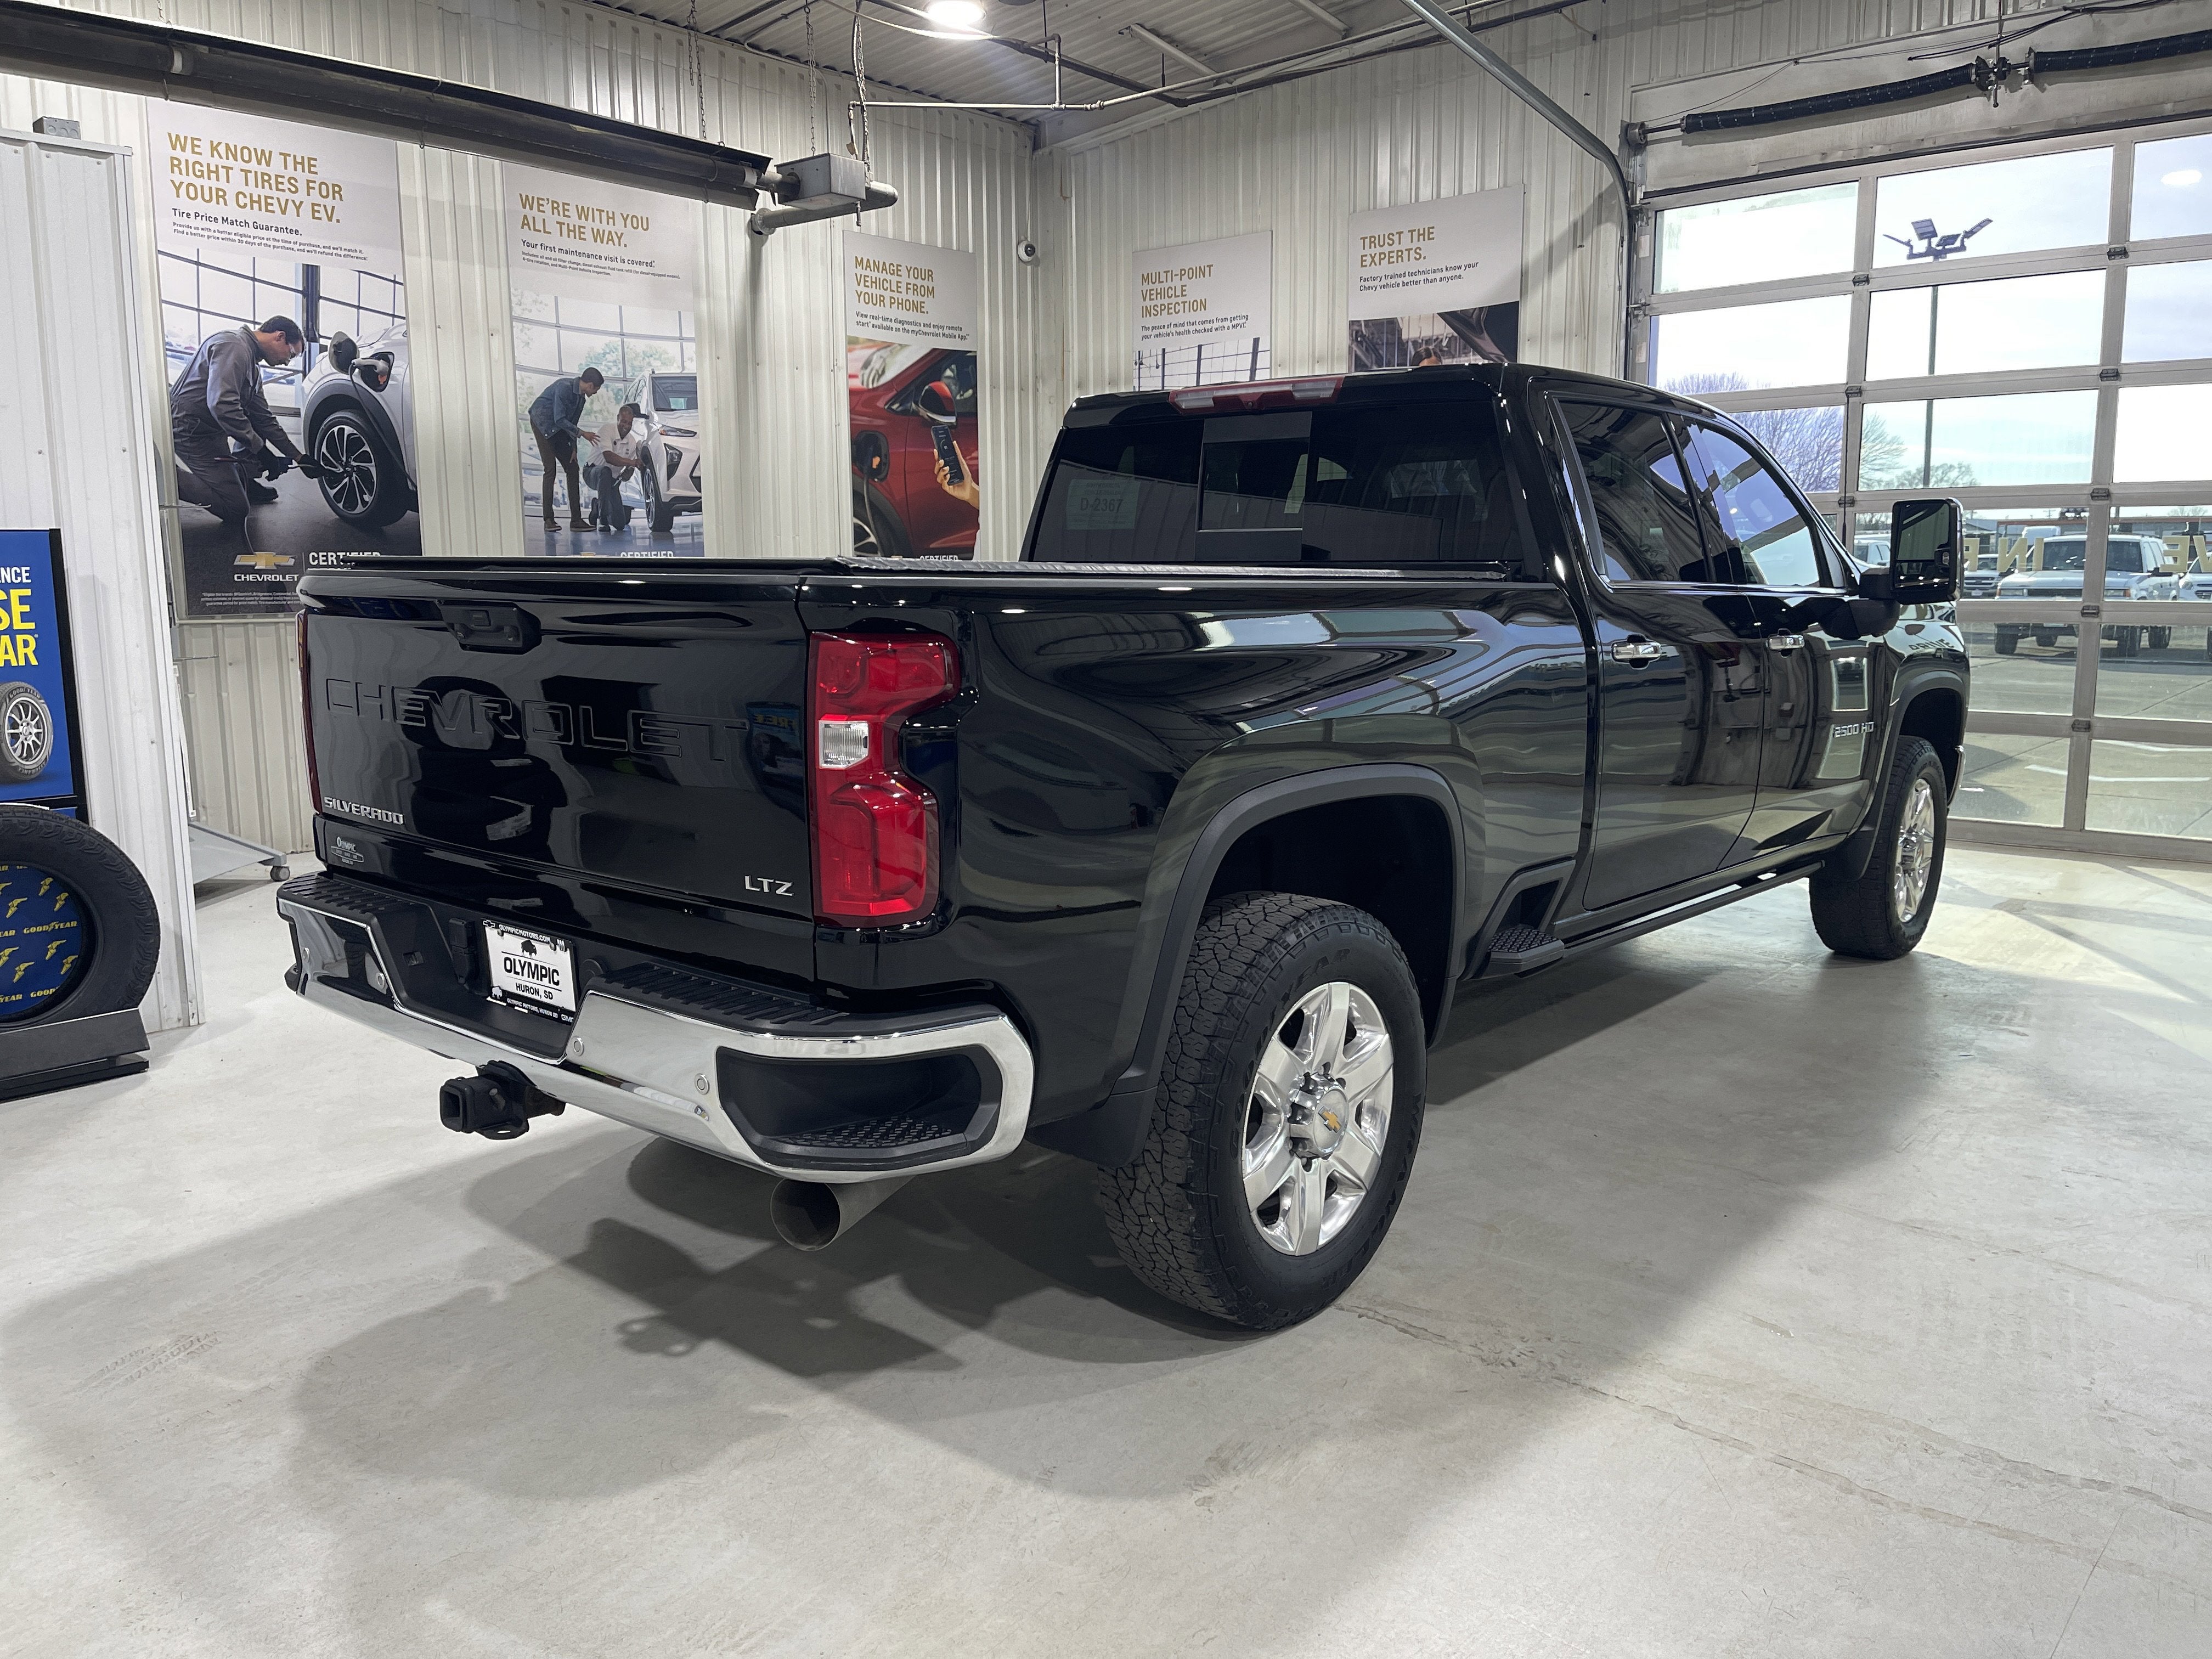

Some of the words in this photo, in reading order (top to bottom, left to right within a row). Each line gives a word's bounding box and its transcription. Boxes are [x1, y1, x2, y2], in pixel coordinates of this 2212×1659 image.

[167, 132, 202, 156] WE
[210, 140, 273, 167] KNOW
[279, 152, 318, 175] THE
[170, 156, 233, 184] RIGHT
[240, 168, 299, 194] TIRES
[306, 179, 344, 201] FOR
[170, 179, 228, 207] YOUR
[235, 191, 304, 217] CHEVY
[311, 202, 340, 223] EV.
[172, 208, 191, 219] Tire
[194, 213, 218, 223] Price
[222, 217, 250, 228] Match
[252, 222, 302, 235] Guarantee.
[519, 193, 571, 218] WE'RE
[575, 205, 616, 227] WITH
[620, 212, 649, 232] YOU
[521, 214, 552, 235] ALL
[556, 221, 586, 241] THE
[591, 227, 627, 247] WAY.
[1360, 230, 1404, 251] TRUST
[1408, 225, 1435, 244] THE
[273, 244, 296, 252] purchase,
[521, 239, 539, 249] Your
[540, 242, 556, 253] first
[558, 247, 602, 261] maintenance
[604, 254, 618, 263] visit
[1360, 246, 1426, 268] EXPERTS.
[855, 256, 902, 277] MANAGE
[905, 265, 934, 283] YOUR
[1141, 264, 1214, 286] MULTI-POINT
[1359, 275, 1383, 283] Factory
[1384, 271, 1406, 280] trained
[1408, 267, 1443, 278] technicians
[1445, 263, 1463, 272] know
[1464, 262, 1479, 271] your
[855, 273, 902, 294] VEHICLE
[905, 282, 935, 299] FROM
[1141, 284, 1187, 302] VEHICLE
[1359, 283, 1378, 292] Chevy
[1379, 280, 1401, 290] vehicle
[1402, 278, 1421, 287] better
[1438, 274, 1464, 283] anyone.
[855, 290, 885, 308] YOUR
[889, 296, 929, 314] PHONE.
[1142, 298, 1206, 318] INSPECTION
[855, 311, 868, 319] View
[869, 314, 893, 323] real-time
[894, 317, 922, 328] diagnostics
[1151, 324, 1165, 332] peace
[1173, 320, 1185, 329] mind
[1229, 314, 1249, 323] getting
[872, 323, 894, 332] available
[911, 330, 941, 338] myChevrolet
[1153, 330, 1174, 338] vehicle's
[1192, 326, 1213, 334] checked
[1080, 497, 1123, 514] D-2367
[0, 567, 31, 583] NCE
[326, 678, 750, 761] CHEVROLET
[1833, 724, 1859, 738] 2500
[1860, 721, 1875, 733] HD
[324, 797, 404, 825] SILVERADO
[744, 875, 794, 896] LTZ
[23, 921, 78, 934] GOODYEAR
[499, 924, 551, 944] OLYMPICMOTORS.COM
[504, 956, 560, 986] OLYMPIC
[515, 982, 543, 999] HURON,
[544, 990, 554, 1000] SD
[506, 998, 522, 1007] OLYMPIC
[539, 1008, 552, 1017] HURON
